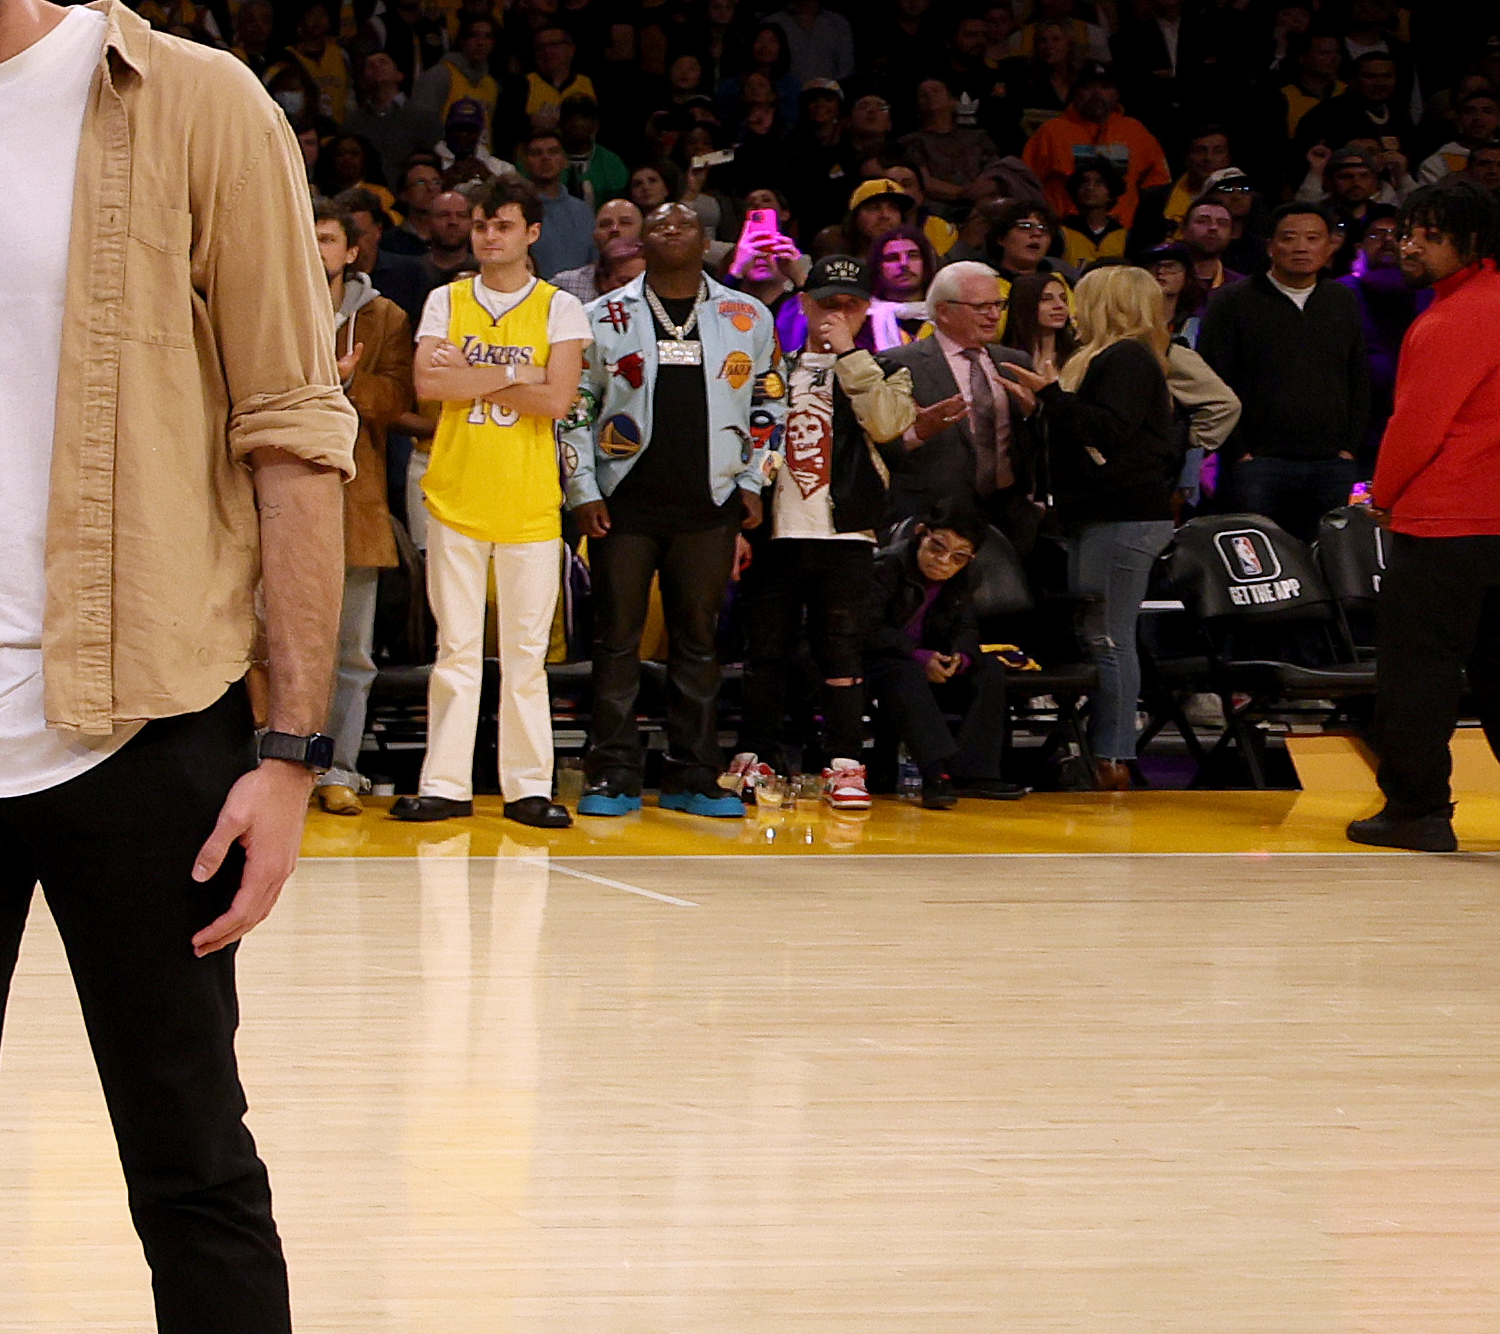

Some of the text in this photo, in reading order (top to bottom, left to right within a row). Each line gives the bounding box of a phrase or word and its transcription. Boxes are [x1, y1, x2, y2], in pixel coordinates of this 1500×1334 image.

[461, 335, 534, 367] LAKERS
[1227, 577, 1301, 606] GET THE APP
